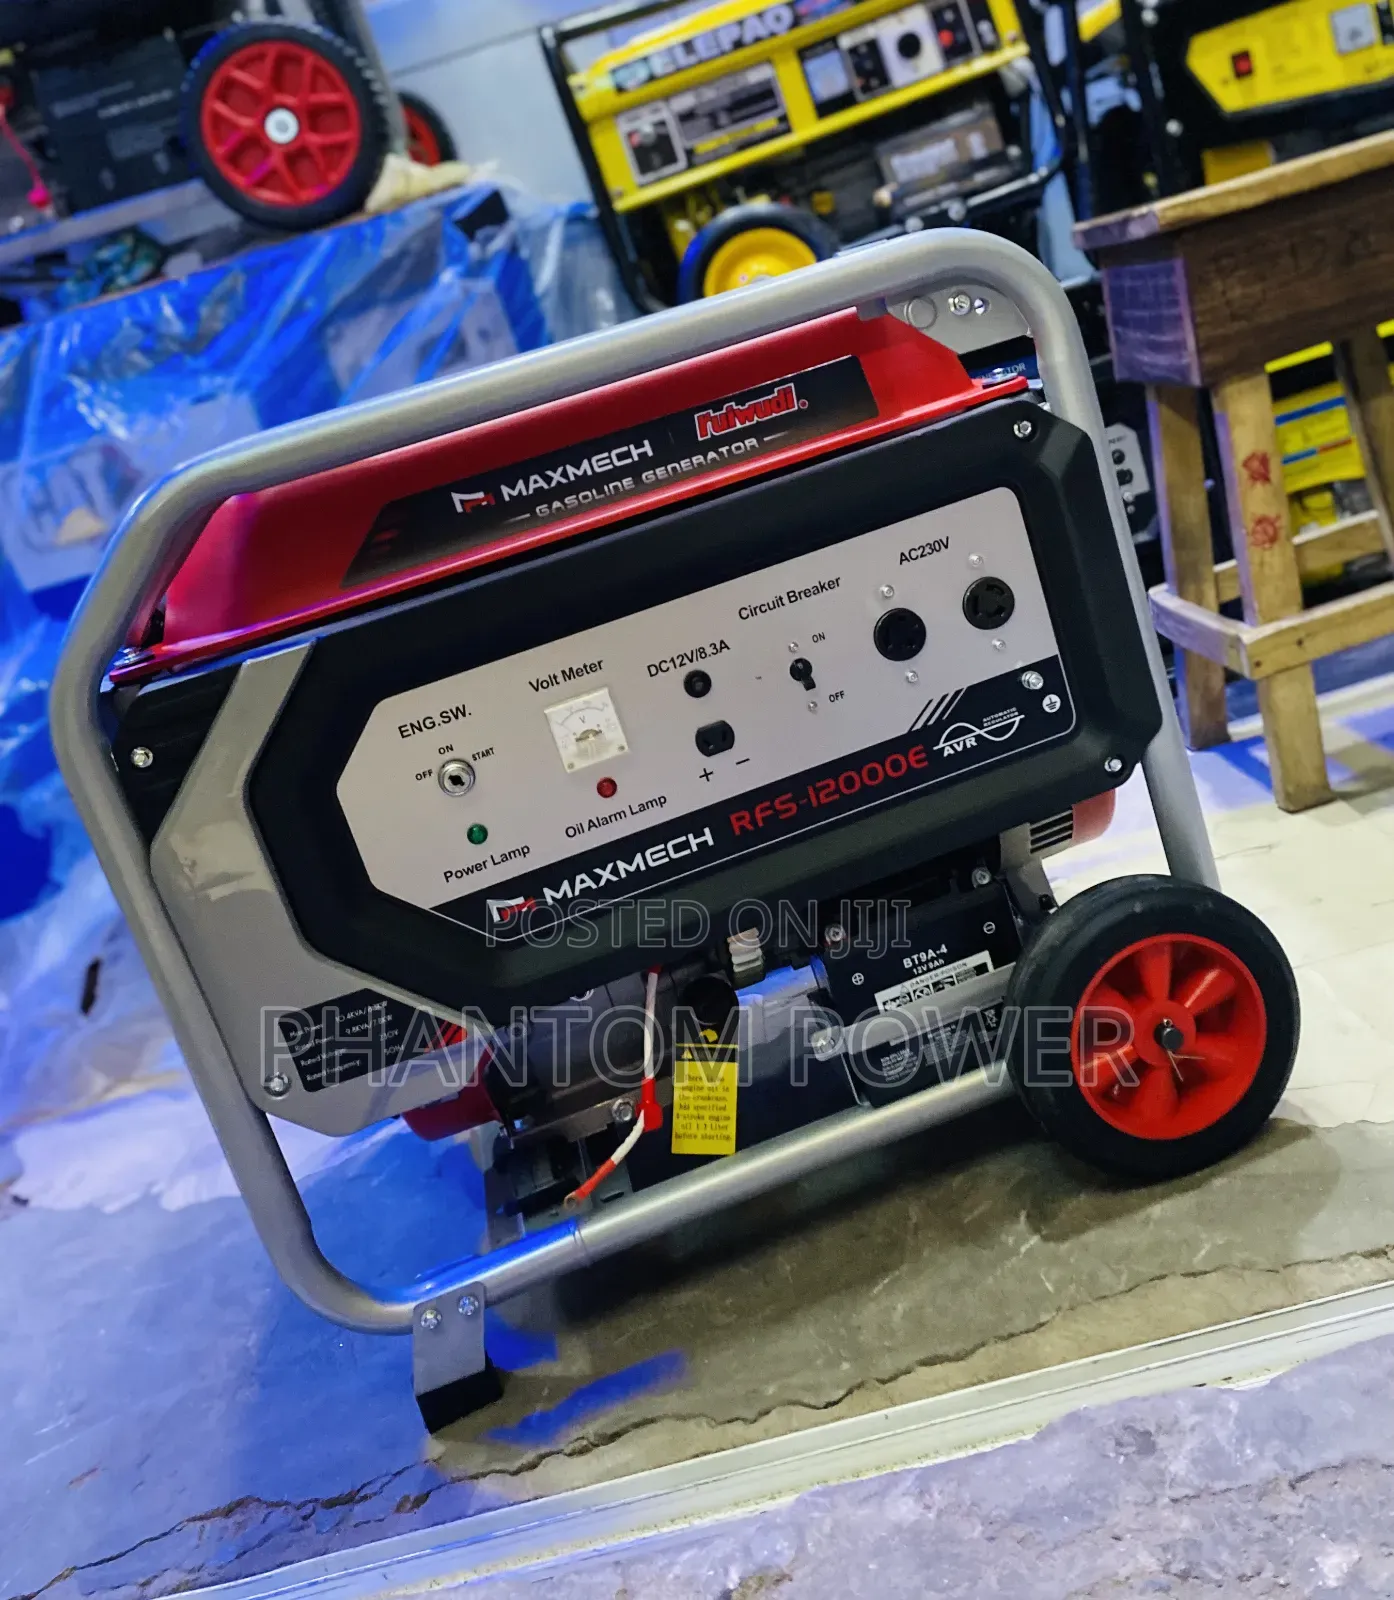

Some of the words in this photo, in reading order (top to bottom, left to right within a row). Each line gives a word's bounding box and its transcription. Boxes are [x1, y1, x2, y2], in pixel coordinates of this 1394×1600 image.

[500, 439, 654, 501] MAXMECH
[535, 477, 635, 518] GASOLINE
[642, 438, 759, 485] GENERATOR
[899, 536, 950, 565] AC230V
[738, 594, 785, 620] Circuit
[786, 577, 841, 605] Breaker
[812, 632, 826, 644] ON
[647, 639, 730, 677] DC12V/8.3A
[529, 673, 561, 693] Volt
[561, 660, 604, 684] Meter
[828, 691, 845, 703] OFF
[398, 704, 472, 739] ENG.SW.
[438, 744, 454, 755] ON
[471, 747, 495, 762] START
[943, 736, 978, 757] AVR
[415, 769, 433, 781] OFF
[542, 827, 715, 906] MAXMECH
[729, 744, 929, 836] RFS-12000E
[565, 822, 585, 839] Oil
[587, 808, 627, 832] Alarm
[627, 793, 667, 819] Lamp
[443, 859, 488, 883] Power
[490, 844, 531, 868] Lamp
[903, 944, 948, 969] BT9A-4
